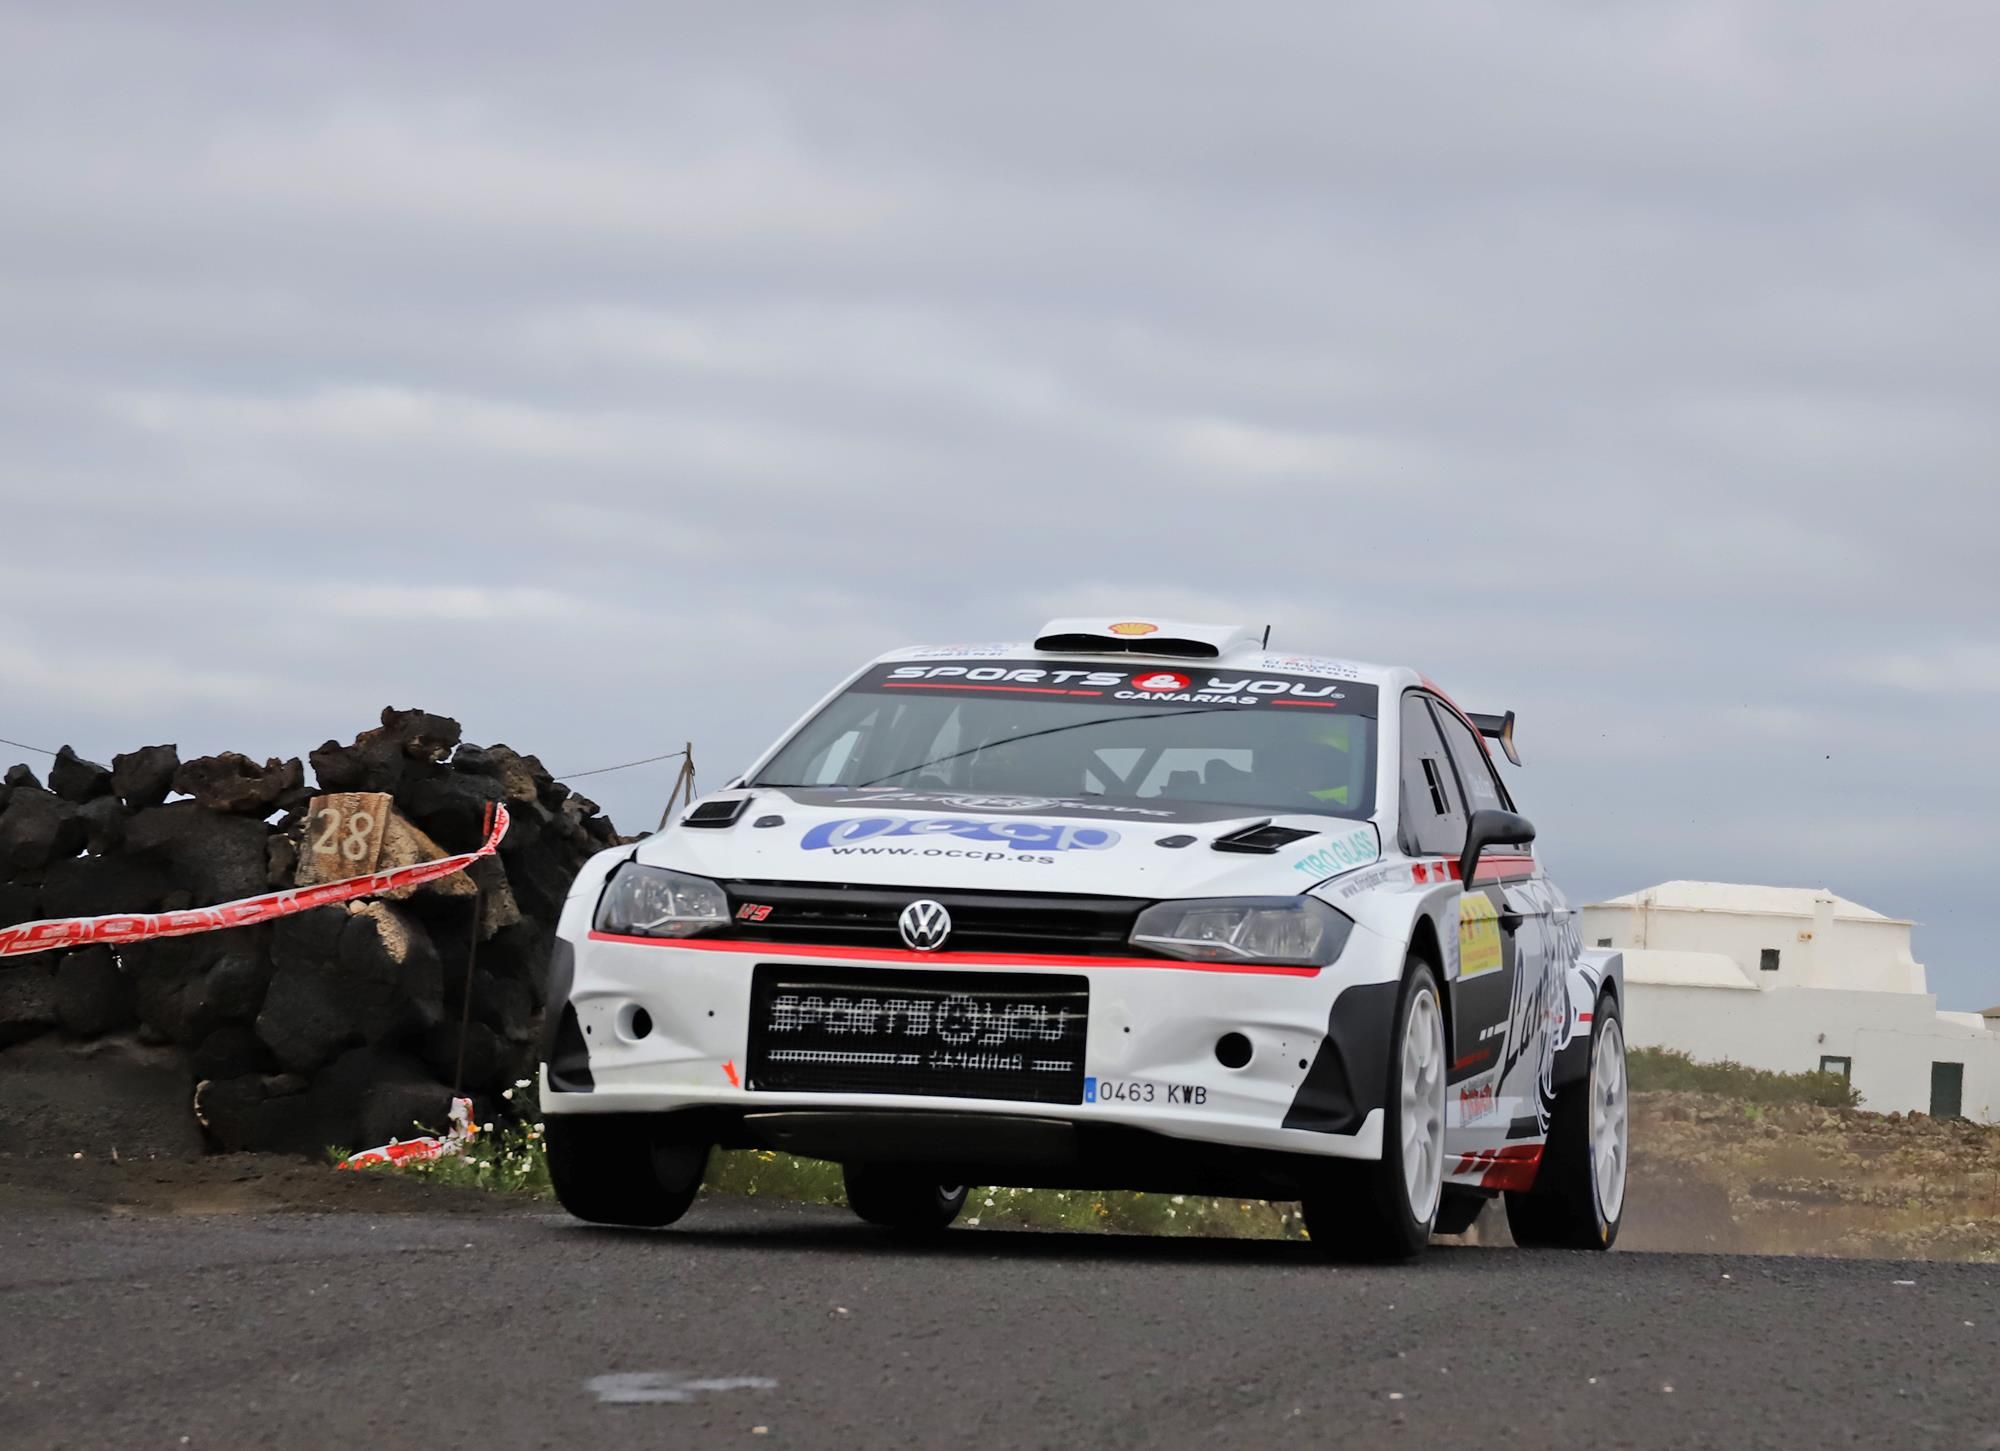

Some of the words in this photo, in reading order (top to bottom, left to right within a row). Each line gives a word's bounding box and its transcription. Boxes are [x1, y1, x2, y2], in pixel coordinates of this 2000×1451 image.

[887, 666, 1128, 686] SPORTS
[1141, 674, 1181, 689] &
[1113, 690, 1259, 705] CANARIAS
[312, 807, 374, 861] 28
[832, 847, 1055, 865] www.occp.es
[1294, 847, 1343, 880] TIRO
[1332, 831, 1378, 865] GLASS
[899, 899, 951, 951] VW
[768, 994, 936, 1035] SPORTS
[1100, 1082, 1155, 1103] 0463
[1167, 1085, 1207, 1105] KWB
